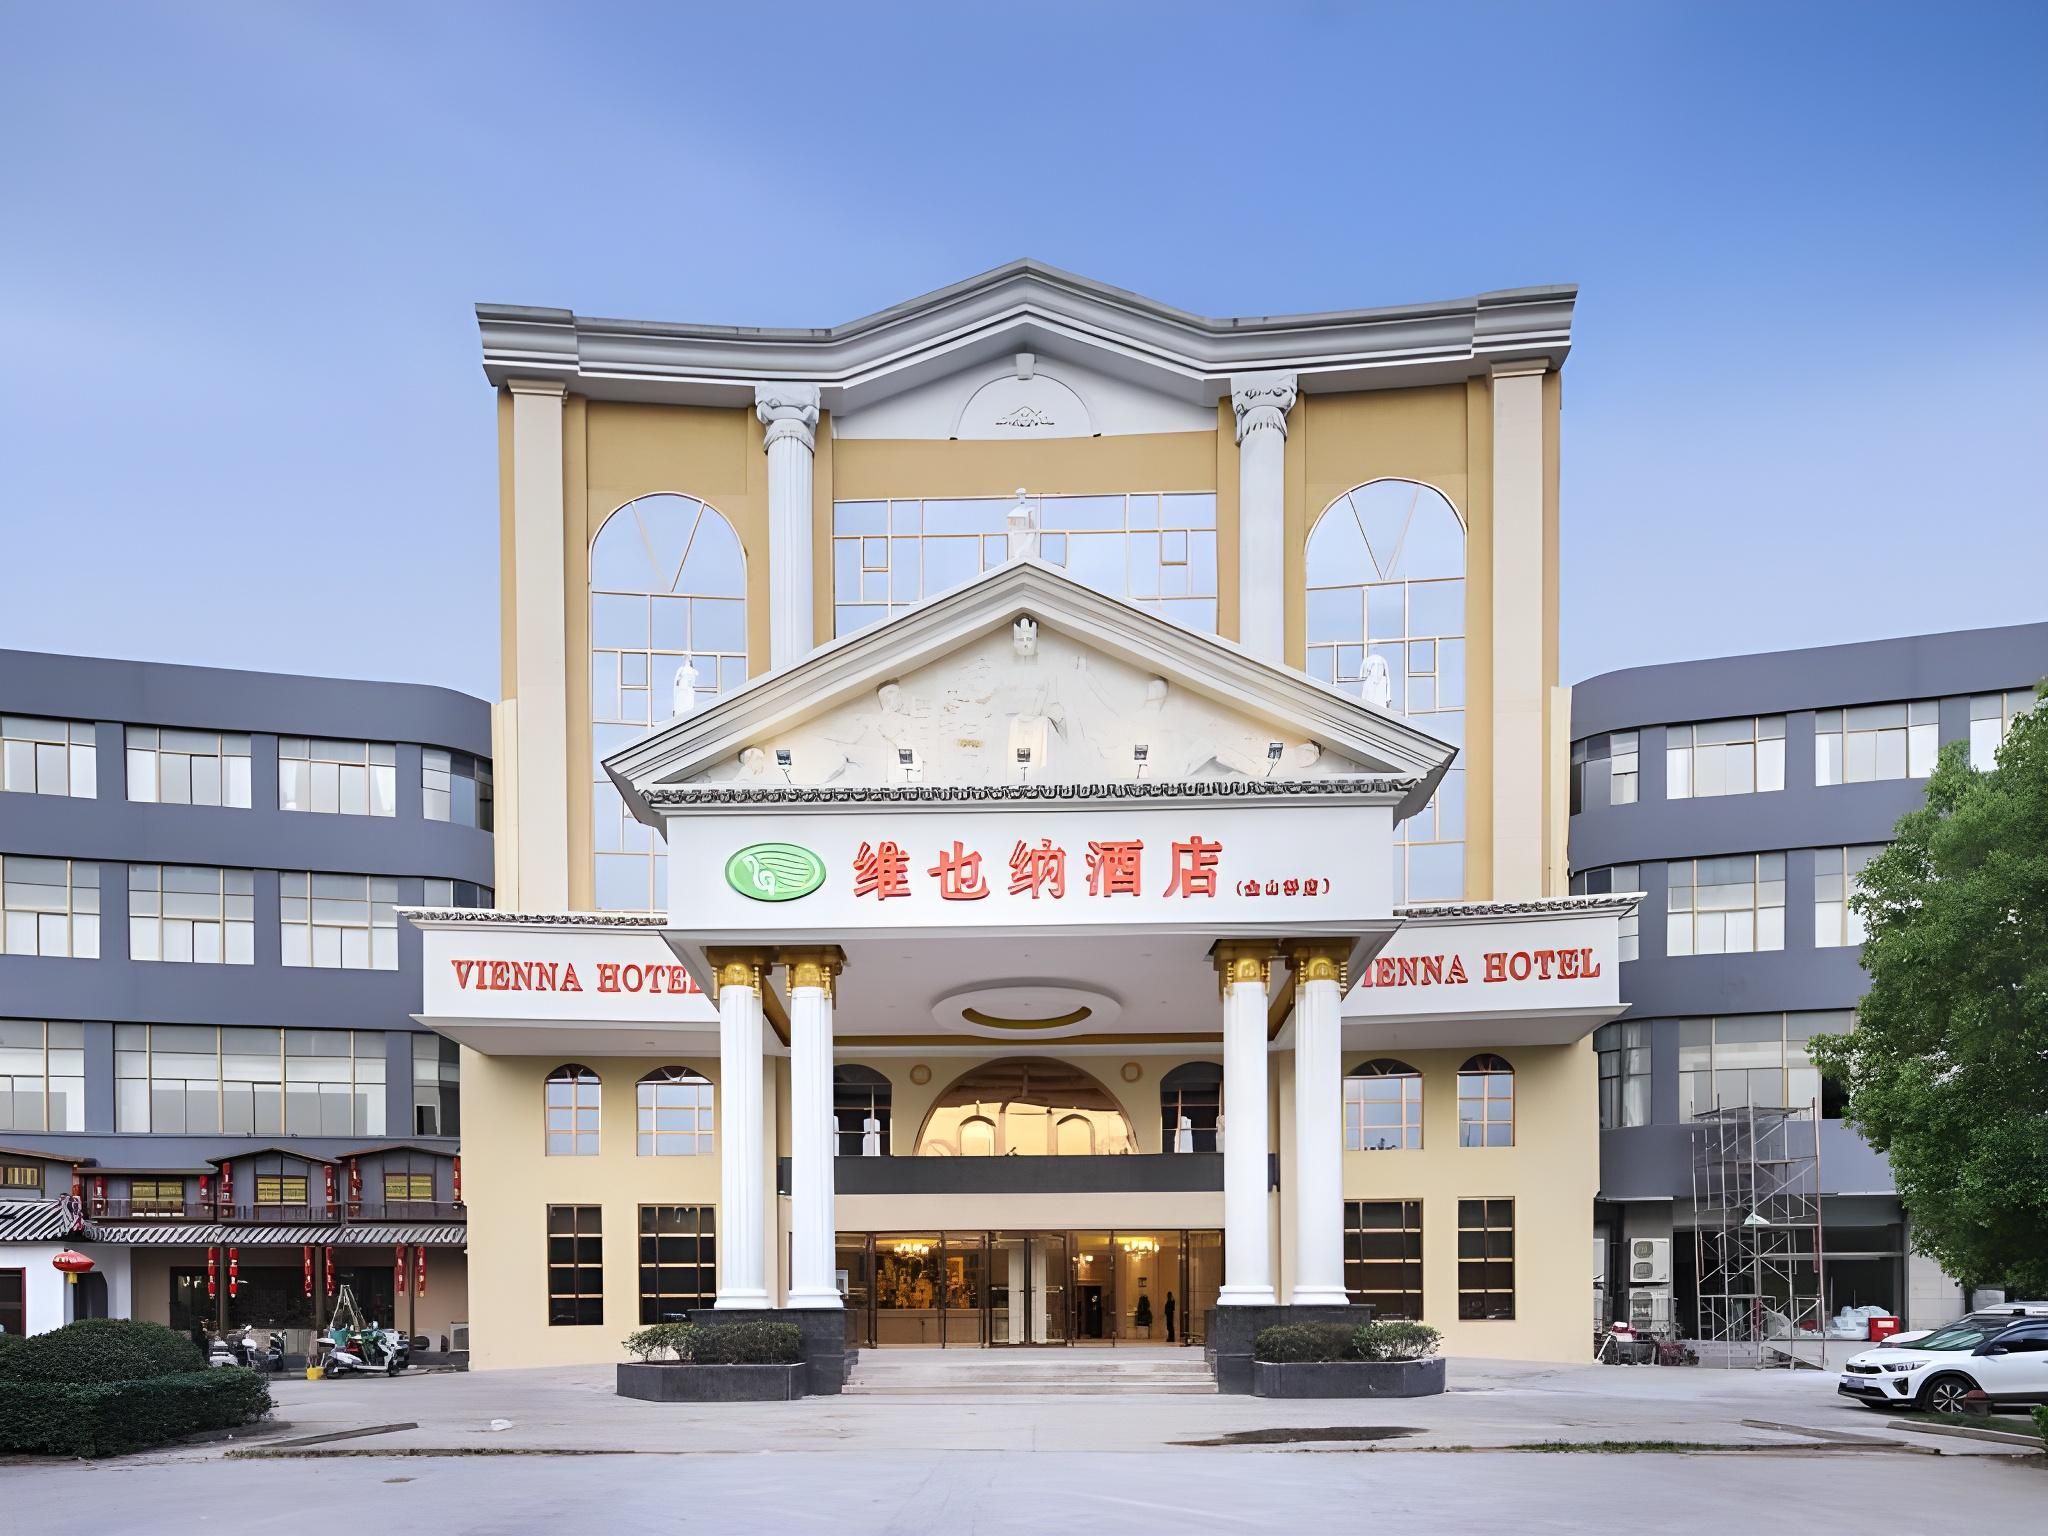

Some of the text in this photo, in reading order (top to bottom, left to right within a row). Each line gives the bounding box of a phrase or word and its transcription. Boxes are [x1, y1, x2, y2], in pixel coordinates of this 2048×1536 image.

[852, 835, 1223, 901] 维也纳酒店
[451, 960, 583, 992] VIENNA
[1361, 948, 1600, 988] IENNA HOTEL
